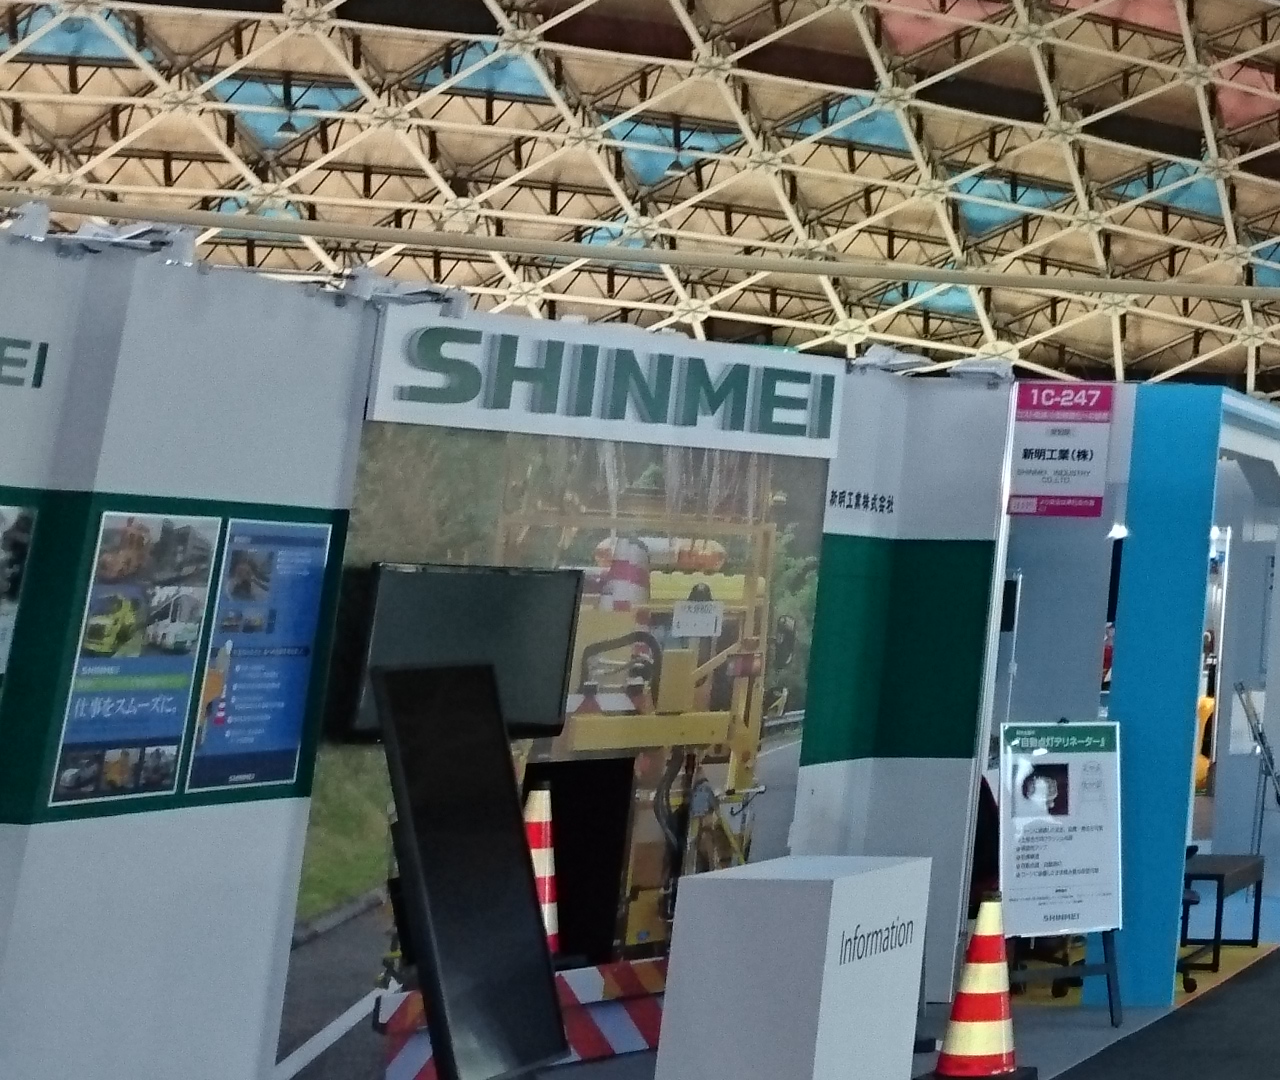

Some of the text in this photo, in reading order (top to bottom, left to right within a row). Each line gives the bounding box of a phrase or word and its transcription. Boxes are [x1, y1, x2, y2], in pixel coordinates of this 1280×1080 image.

[393, 326, 836, 440] SHINMEI
[1031, 389, 1101, 406] 1C-247
[840, 915, 914, 966] Information
